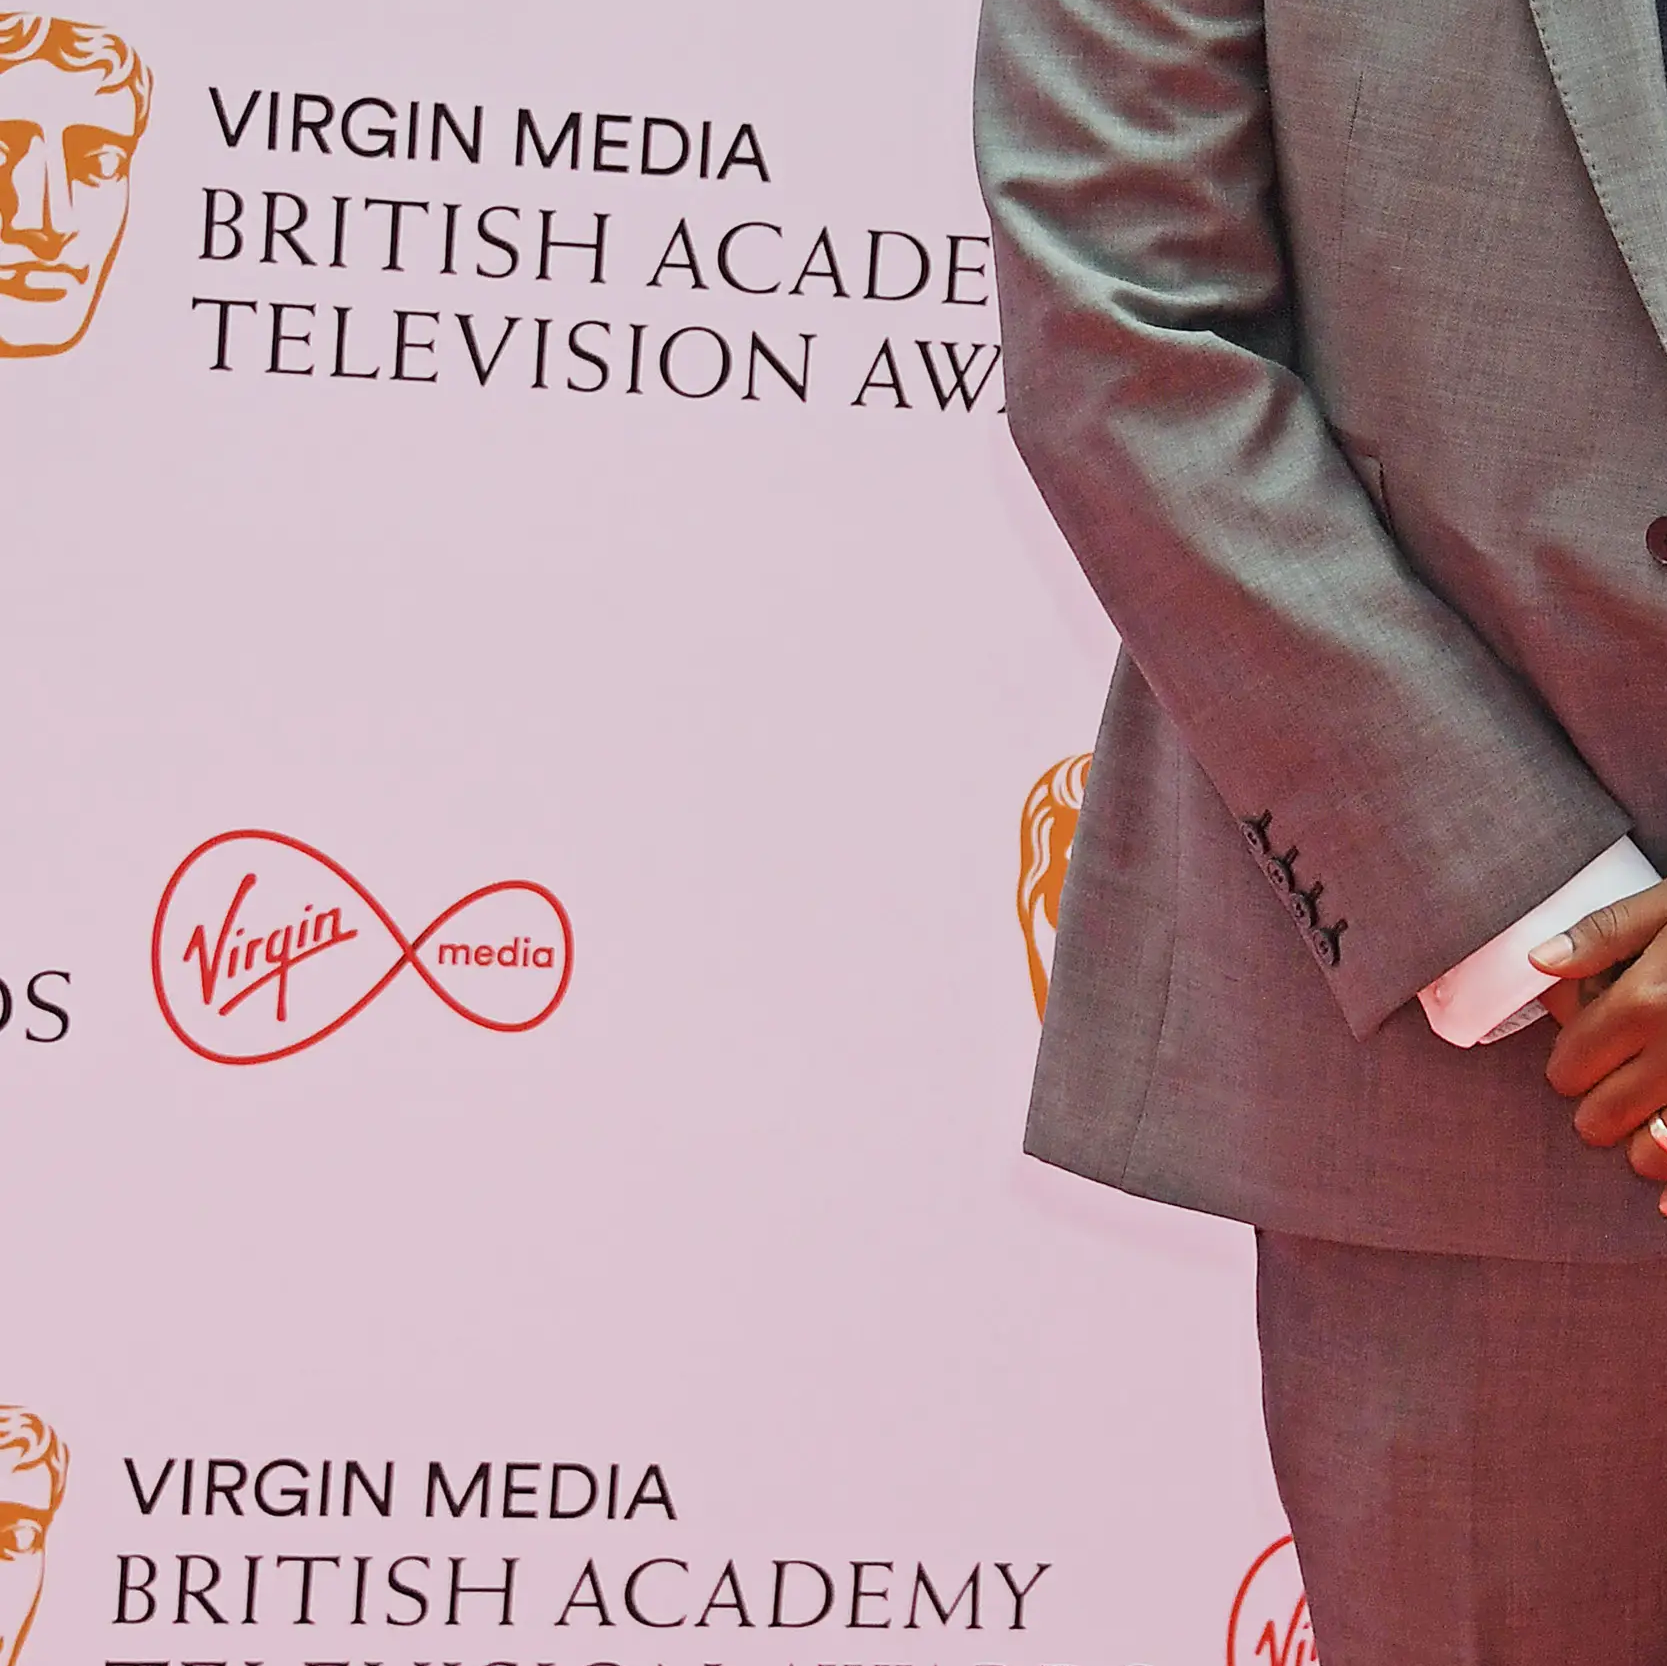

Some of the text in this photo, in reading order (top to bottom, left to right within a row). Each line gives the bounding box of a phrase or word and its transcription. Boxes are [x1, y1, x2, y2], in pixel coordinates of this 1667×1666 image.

[208, 87, 771, 183] VIRGIN MEDIA
[198, 187, 990, 306] BRITISH ACADE
[192, 297, 817, 403] TELEVISION
[183, 873, 554, 1022] Virgin media
[124, 1457, 677, 1520] VIRGIN MEDIA
[112, 1555, 1052, 1630] BRITISH ACADEMY
